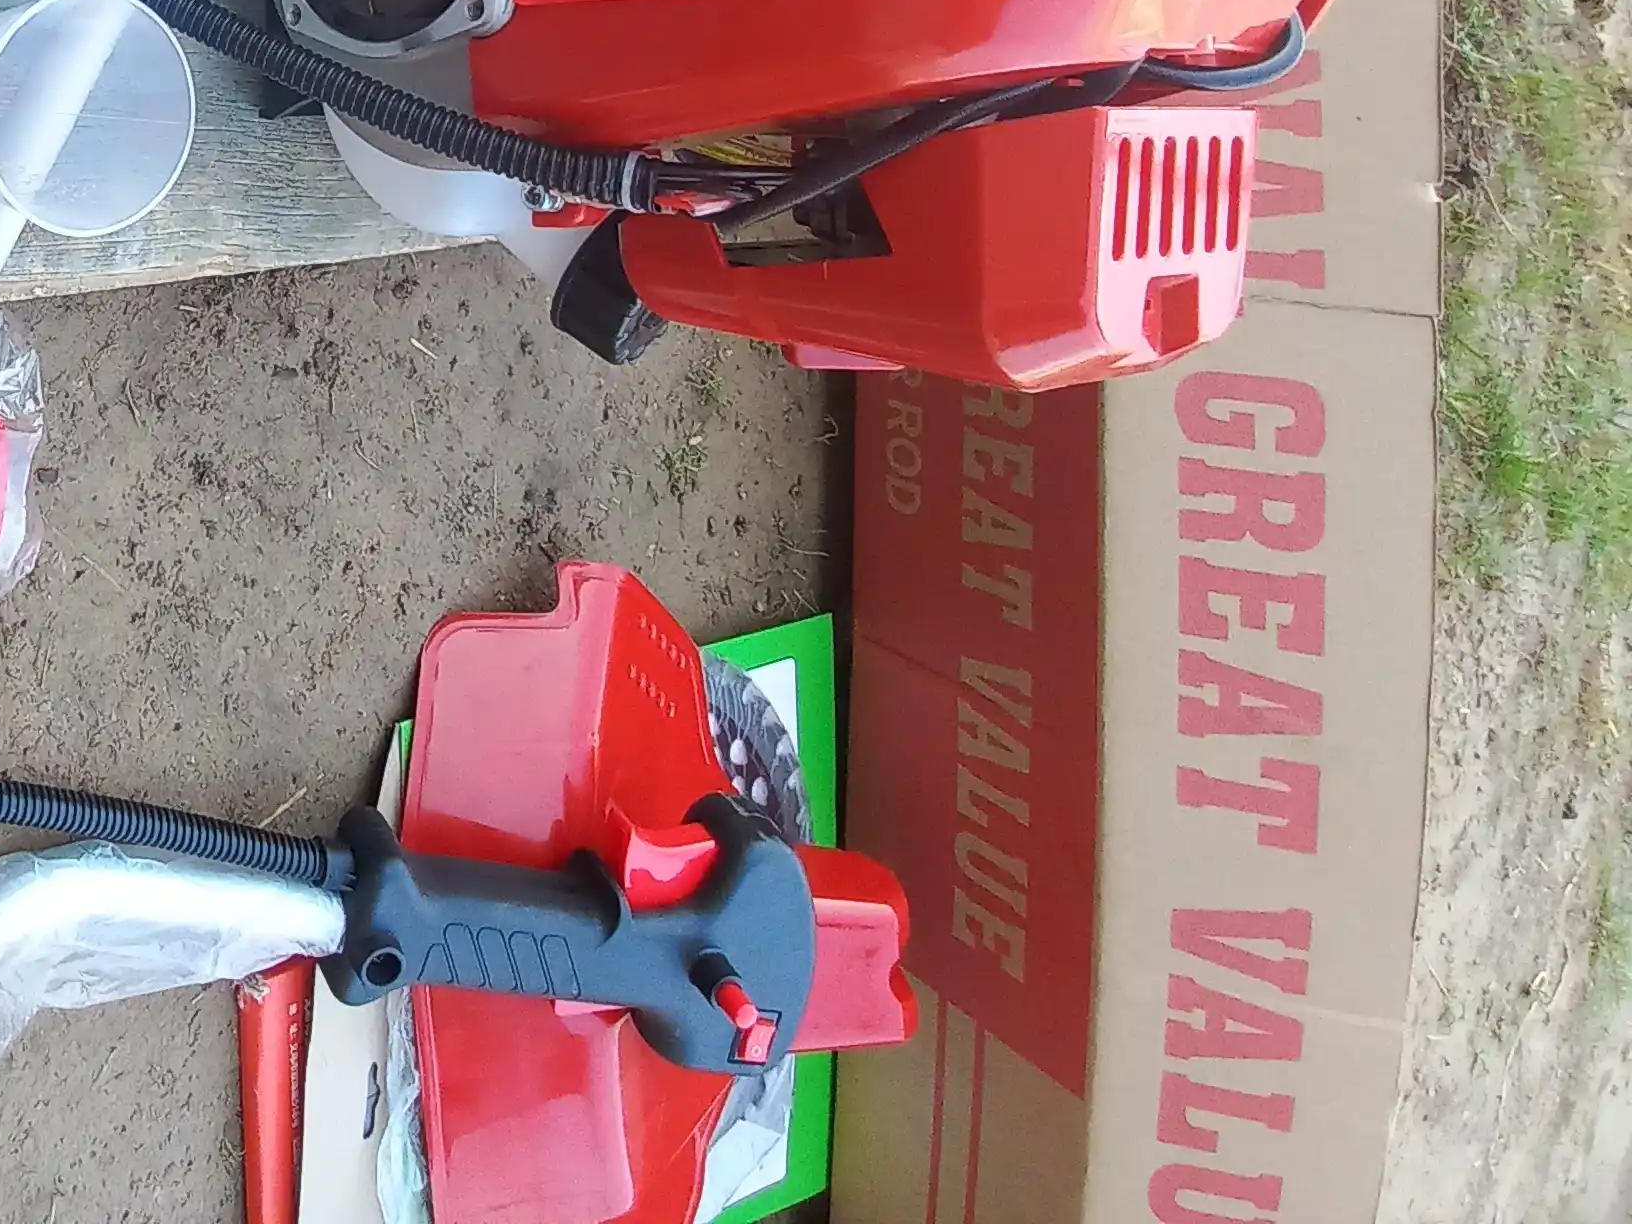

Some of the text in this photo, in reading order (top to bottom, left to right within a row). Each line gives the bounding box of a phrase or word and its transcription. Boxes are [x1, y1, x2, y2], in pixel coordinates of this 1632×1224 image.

[886, 400, 923, 515] ROD
[952, 380, 1035, 982] REAT VALUE
[1174, 371, 1326, 855] GREAT
